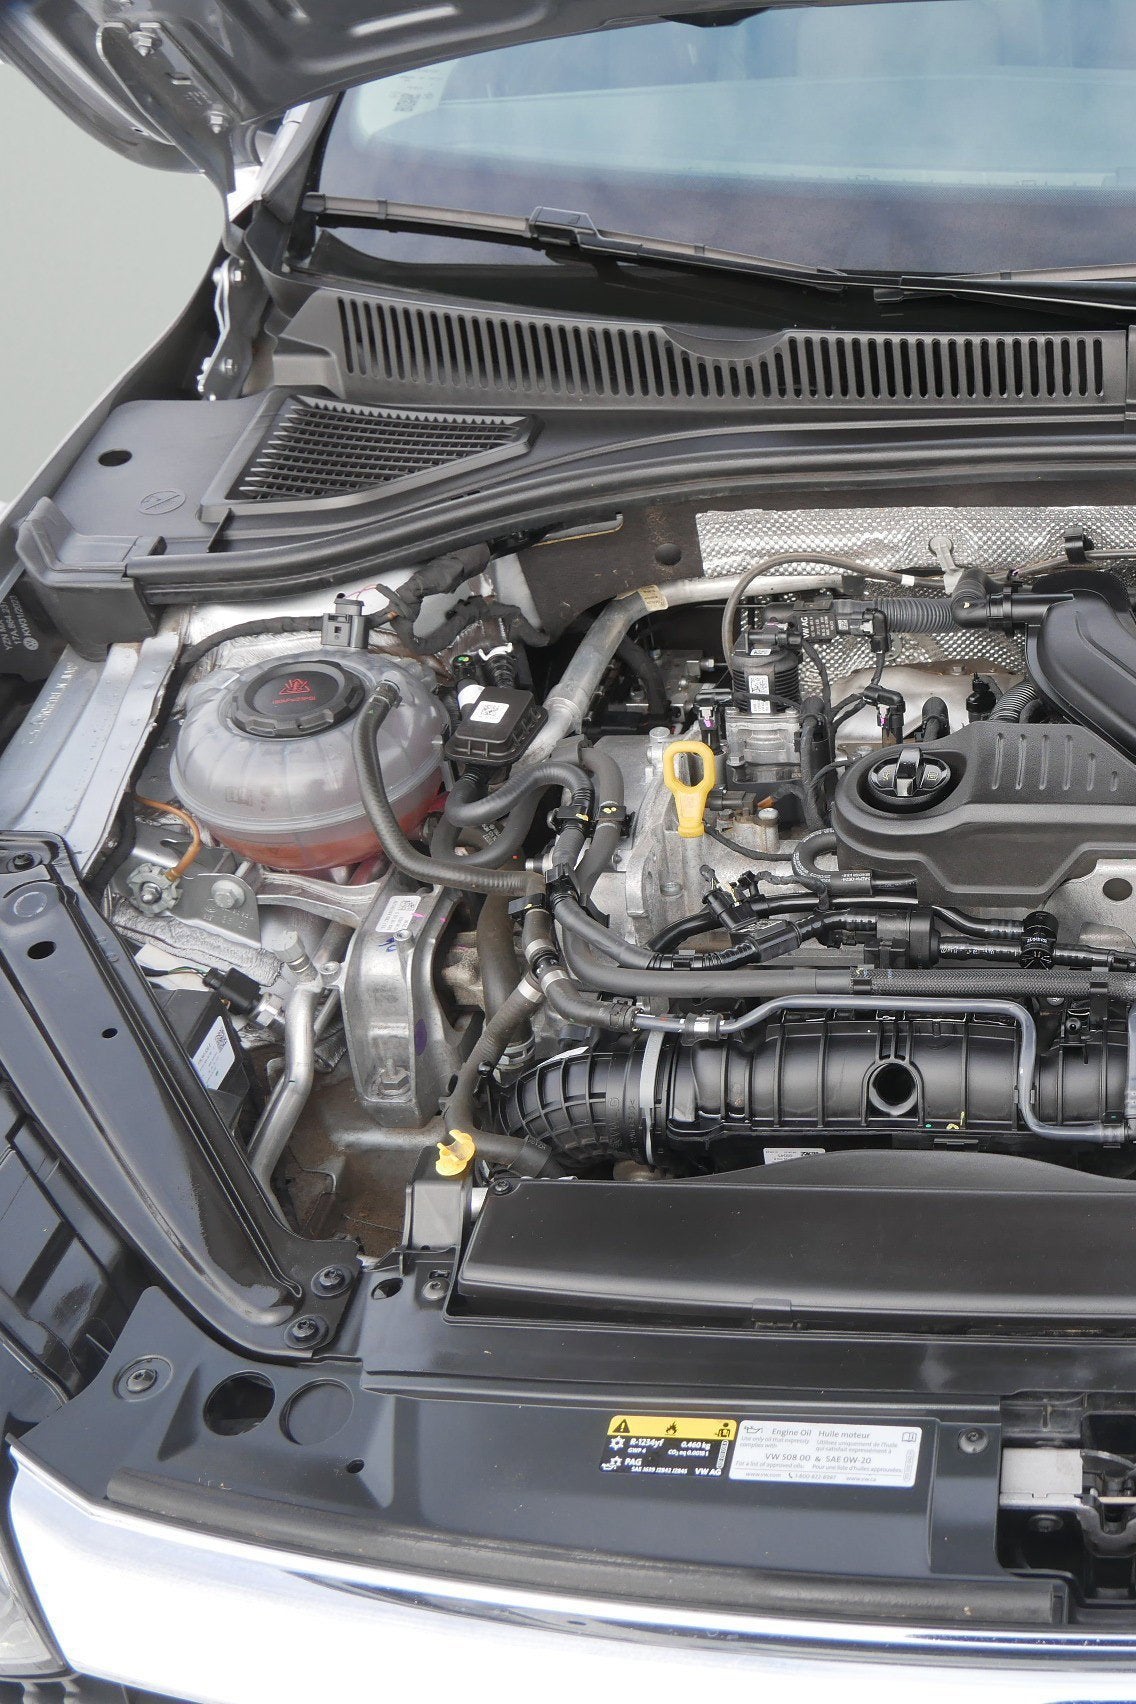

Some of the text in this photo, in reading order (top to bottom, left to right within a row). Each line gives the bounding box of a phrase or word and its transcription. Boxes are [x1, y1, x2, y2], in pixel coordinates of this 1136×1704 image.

[772, 1428, 812, 1437] Engine Oil
[818, 1430, 839, 1438] Huile
[629, 1438, 665, 1448] R-1234yf
[701, 1442, 711, 1450] kg
[782, 1453, 797, 1461] 508
[843, 1456, 872, 1464] 0W-20
